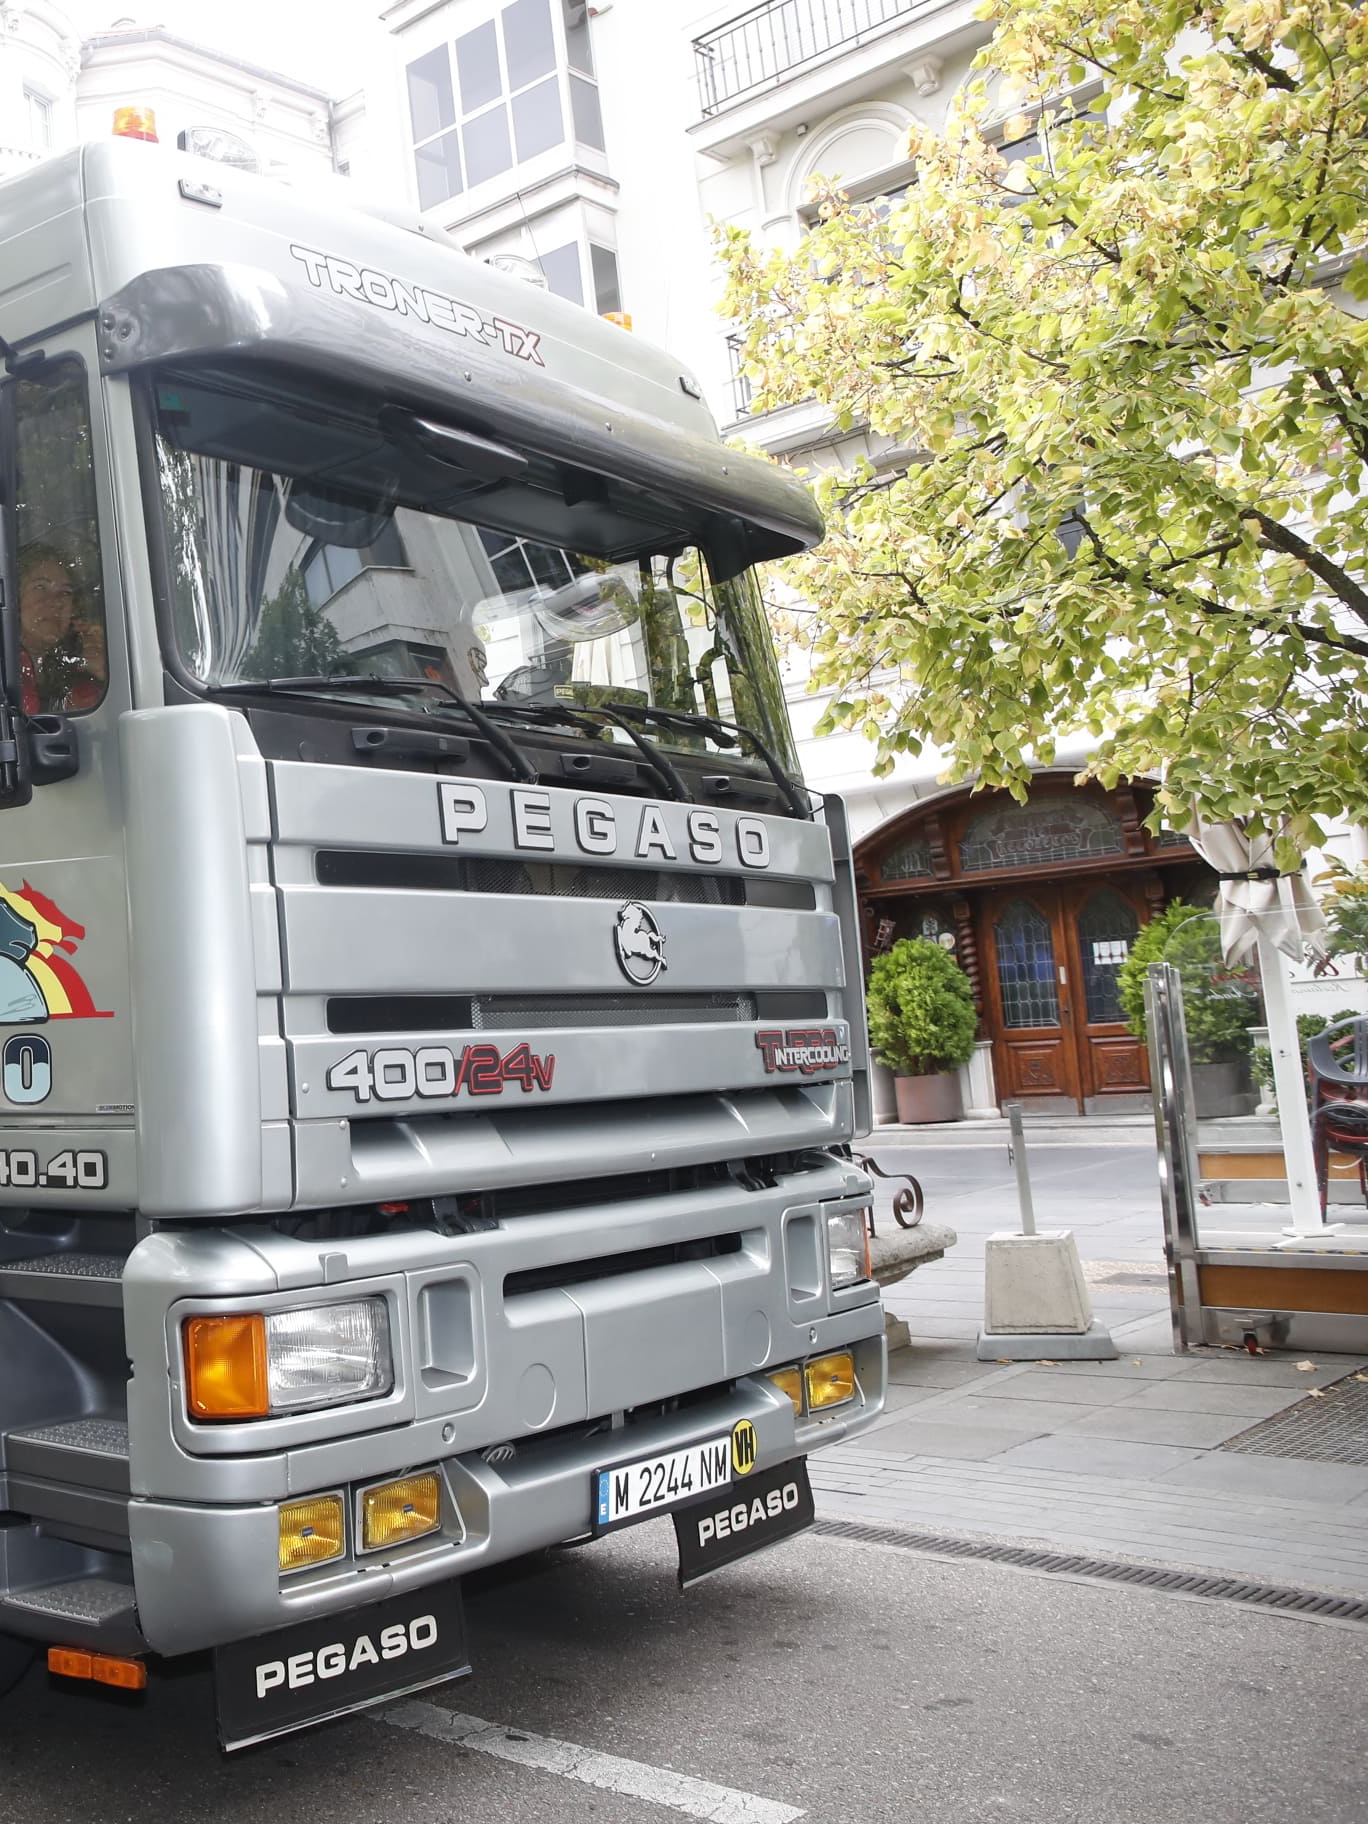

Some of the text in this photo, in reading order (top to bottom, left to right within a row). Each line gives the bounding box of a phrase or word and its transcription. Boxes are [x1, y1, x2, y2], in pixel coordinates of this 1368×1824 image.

[290, 244, 546, 368] TRONER-TX
[437, 781, 770, 869] PEGASO
[774, 1045, 849, 1066] INTERCOOLING
[615, 1444, 727, 1515] M 2244 NM
[735, 1426, 754, 1468] VH
[600, 1503, 606, 1516] E
[698, 1481, 799, 1548] PEGASO
[255, 1614, 438, 1699] PEGASO
